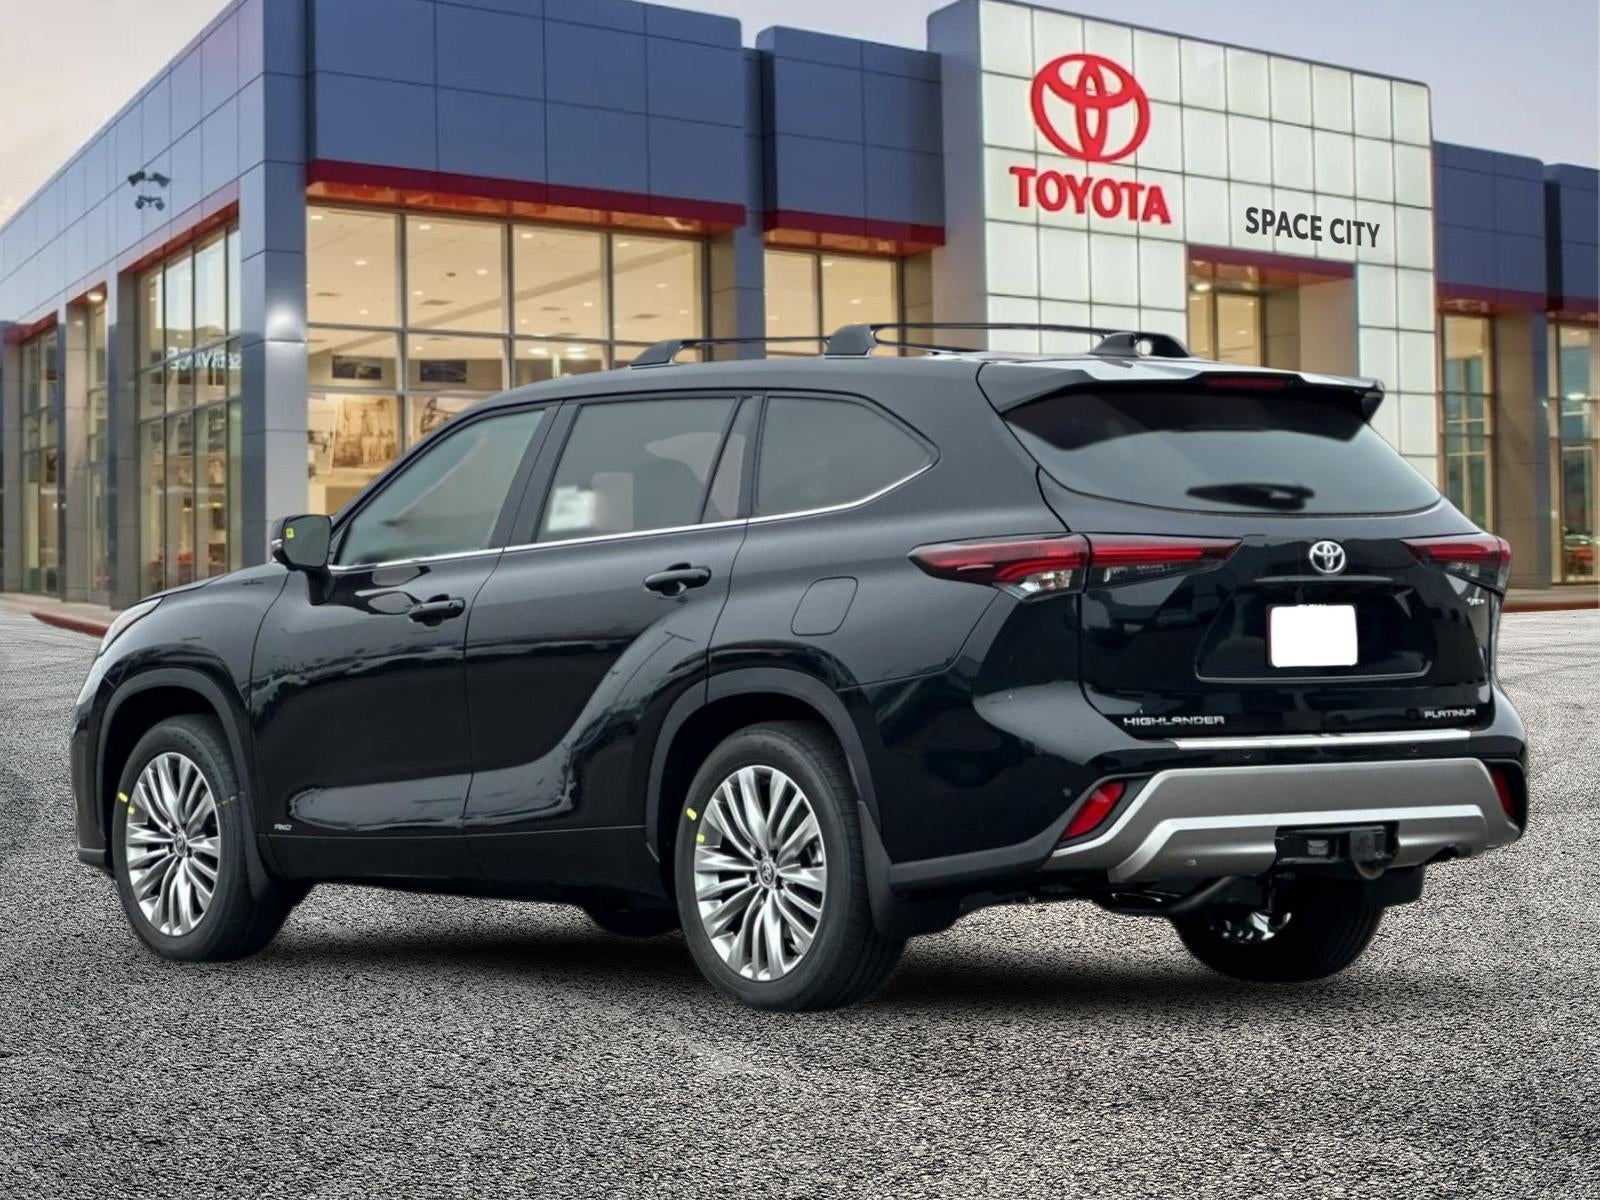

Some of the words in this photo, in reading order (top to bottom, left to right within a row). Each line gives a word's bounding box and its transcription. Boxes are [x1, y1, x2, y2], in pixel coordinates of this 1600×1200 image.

[1009, 166, 1171, 224] TOYOTA
[1245, 206, 1323, 242] SPACE
[1329, 217, 1381, 248] CITY
[1123, 715, 1225, 726] HIGHLANDER
[1424, 708, 1477, 719] PLATINUM
